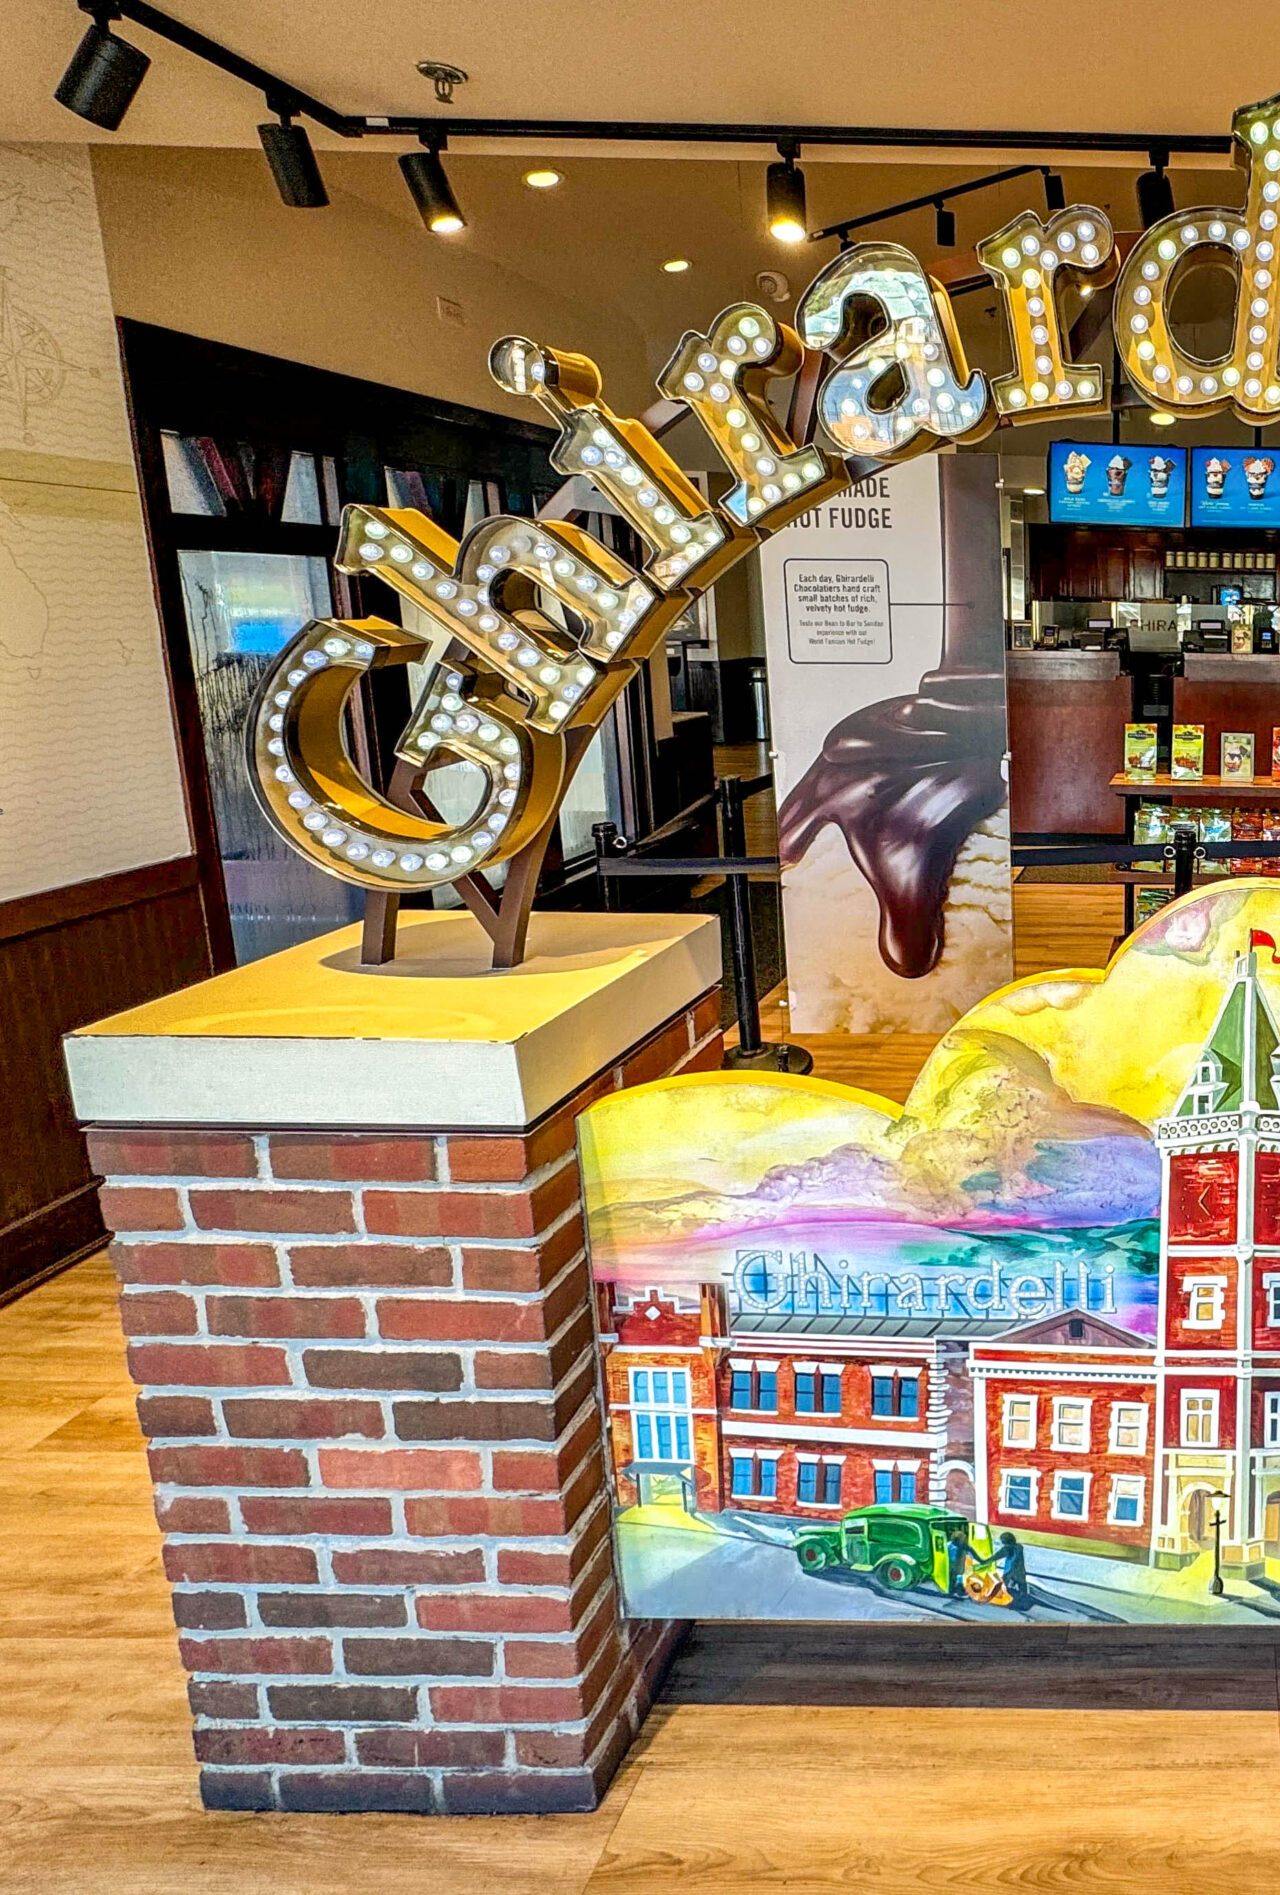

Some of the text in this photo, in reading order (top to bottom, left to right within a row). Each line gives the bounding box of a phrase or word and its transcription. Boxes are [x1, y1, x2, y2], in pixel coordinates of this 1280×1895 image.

[829, 508, 892, 528] FUDGE
[799, 574, 875, 584] Each day, Ghirardelli
[794, 584, 881, 593] Chocolatiers hand craft
[798, 594, 818, 602] small
[820, 594, 849, 602] batches
[860, 595, 878, 603] rich,
[806, 604, 871, 614] velvety hot fudge.
[734, 1250, 1117, 1315] Ghirardelli
